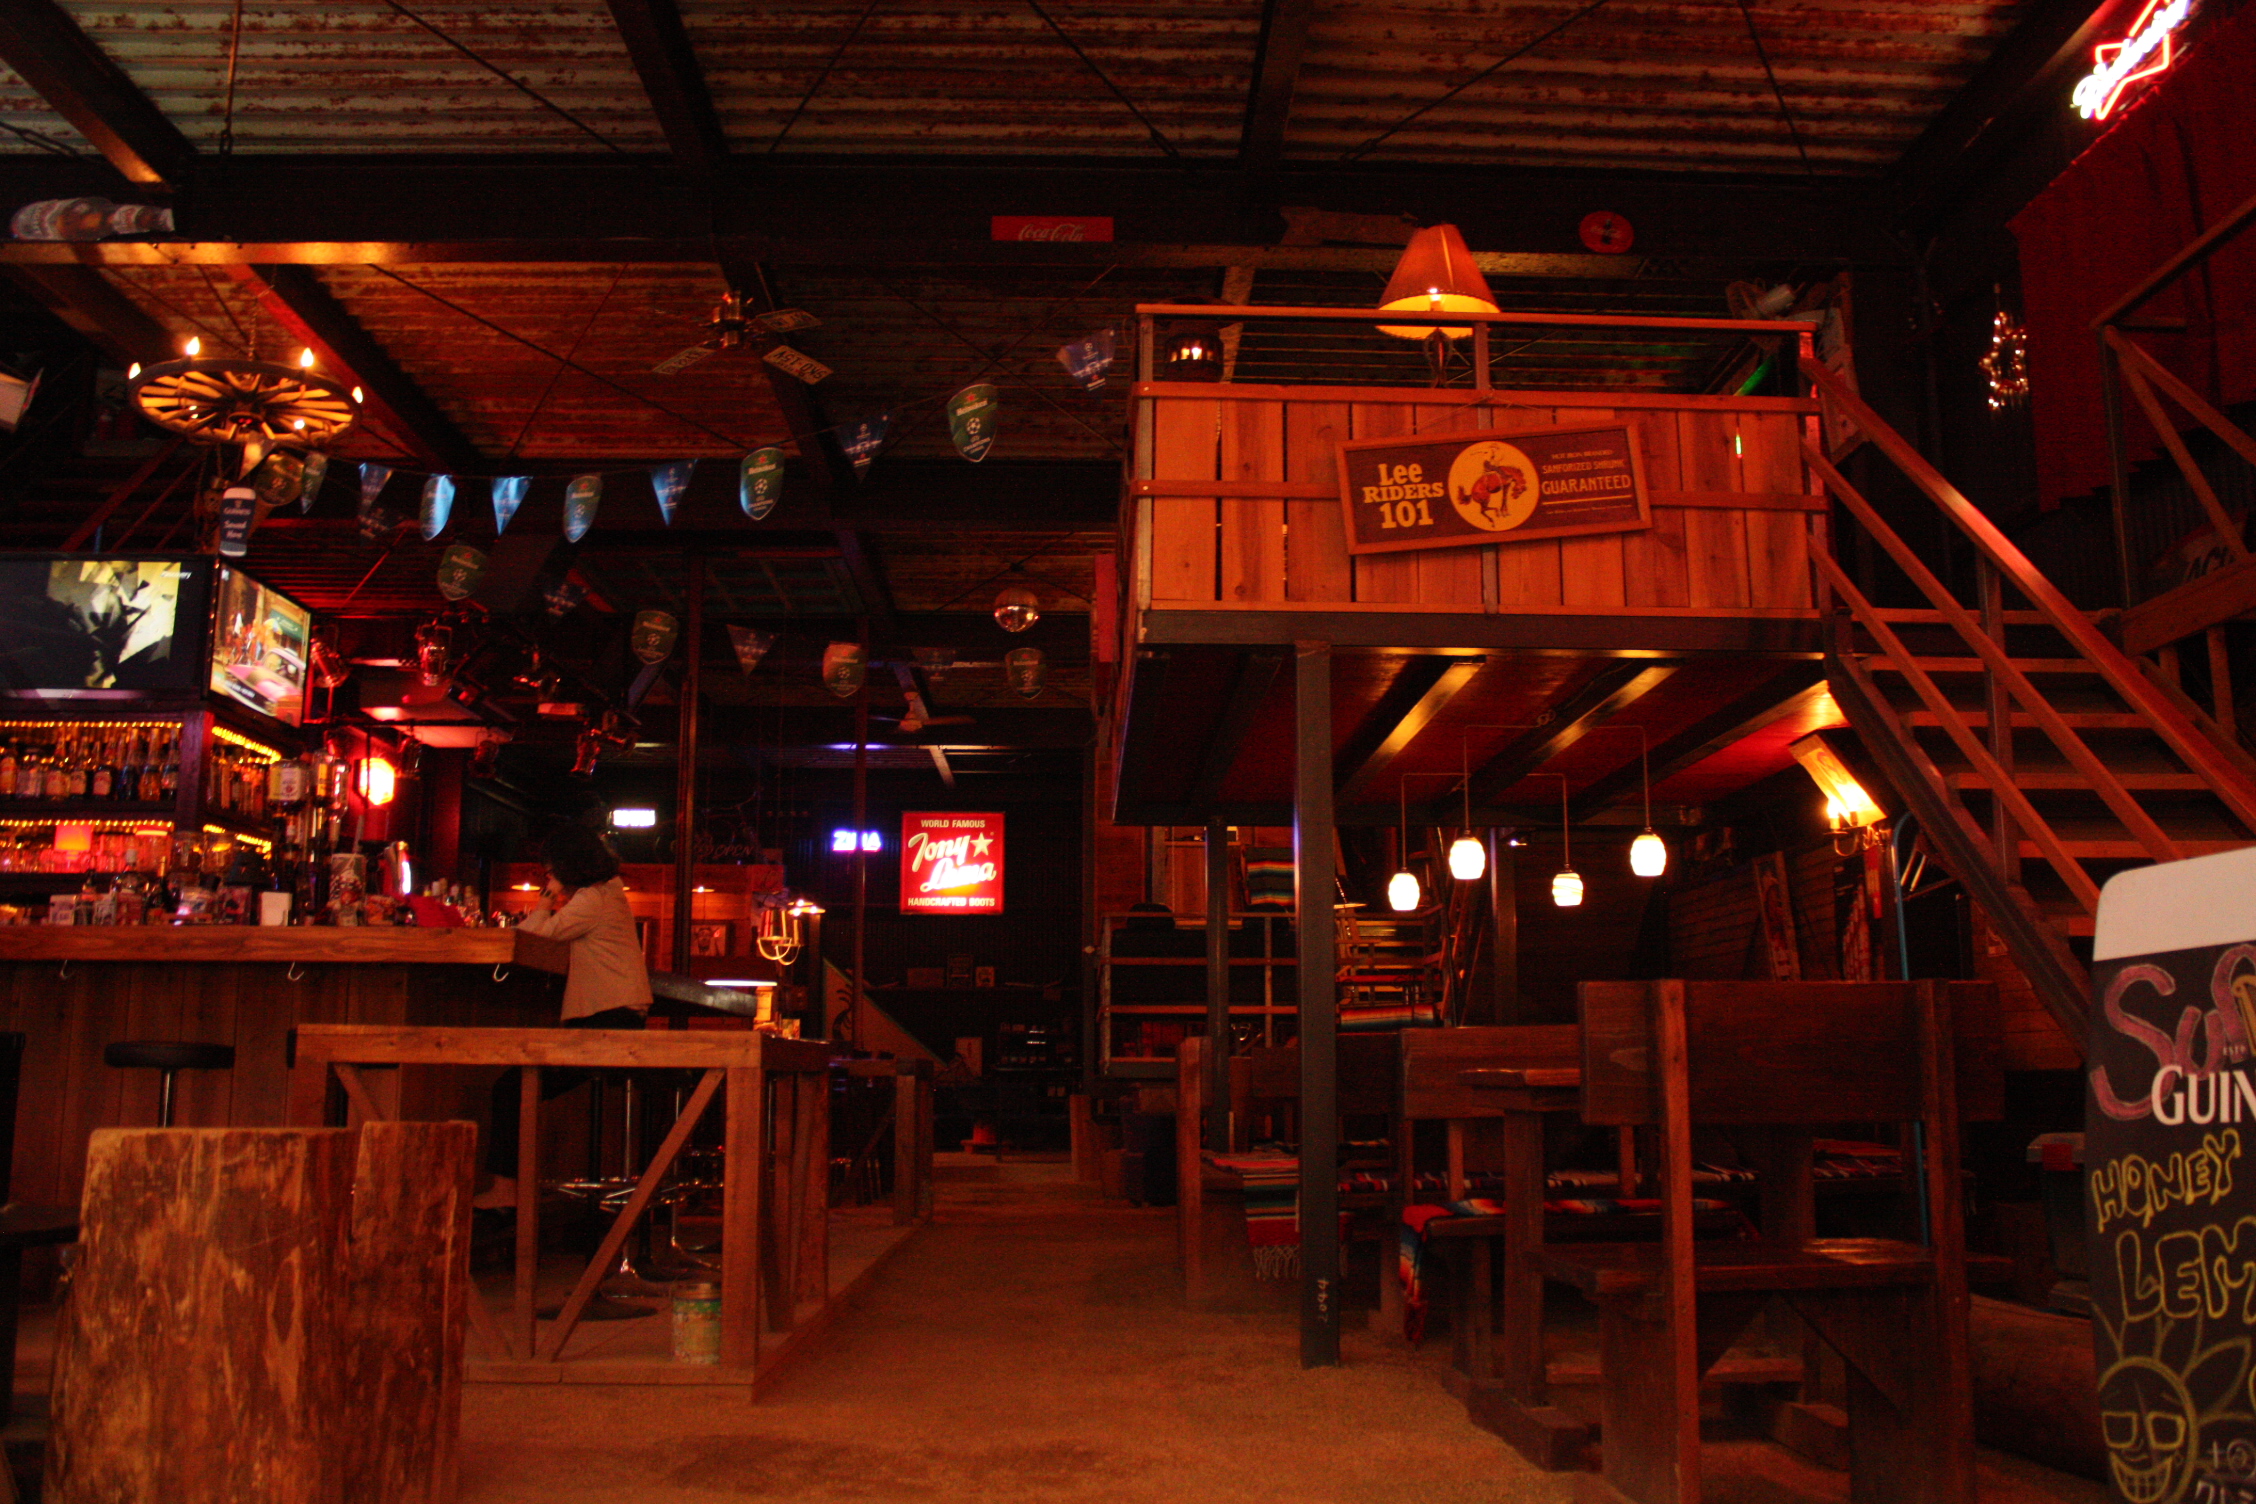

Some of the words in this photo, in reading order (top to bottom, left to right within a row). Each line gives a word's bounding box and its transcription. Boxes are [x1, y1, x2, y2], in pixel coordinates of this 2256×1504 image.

[1378, 463, 1423, 486] Lee
[1541, 474, 1632, 495] GUARANTEED
[1362, 482, 1445, 504] RIDERS
[1379, 499, 1435, 529] 101
[920, 819, 949, 828] WORLD
[951, 819, 986, 828] FAMOUS
[908, 832, 971, 872] Tony
[968, 897, 996, 907] BOOTS
[2091, 1128, 2242, 1234] HONEY
